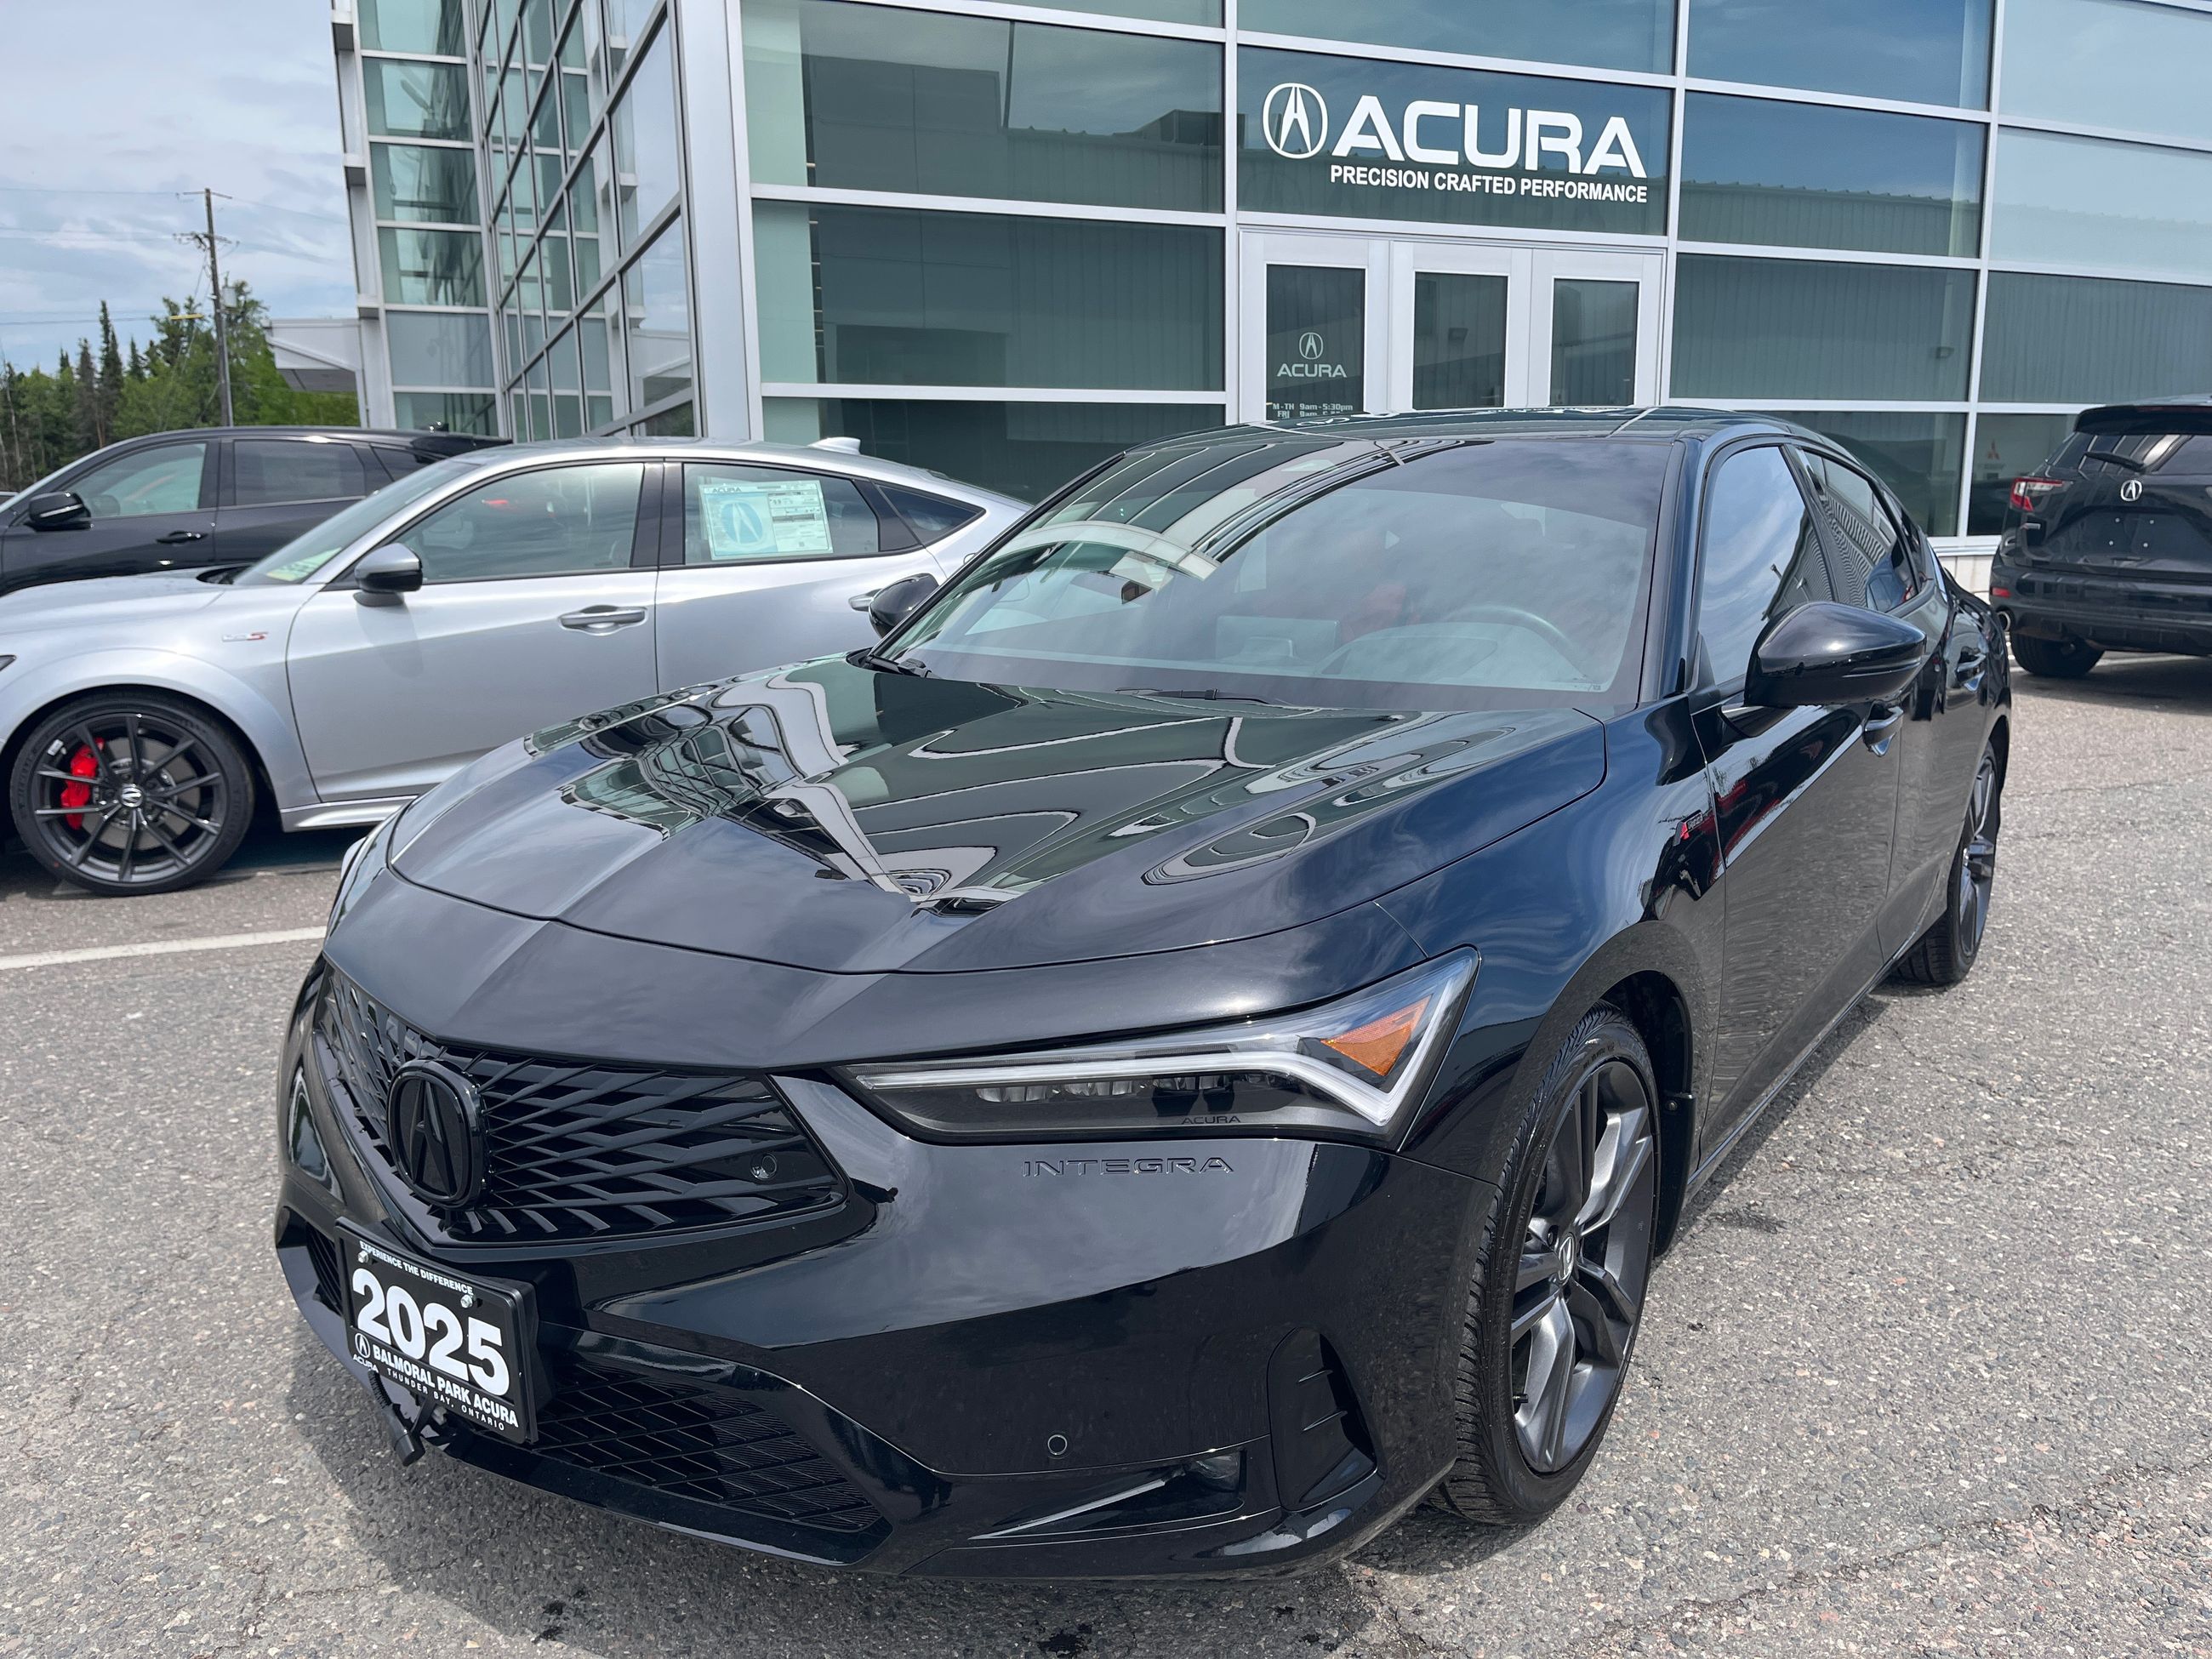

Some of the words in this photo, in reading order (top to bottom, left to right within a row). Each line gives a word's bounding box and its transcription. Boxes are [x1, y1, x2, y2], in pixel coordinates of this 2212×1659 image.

[1331, 94, 1647, 178] ACURA
[1331, 165, 1429, 190] PRECISION
[1434, 173, 1516, 195] CRAFTED
[1520, 178, 1647, 203] PERFORMANCE
[1276, 363, 1348, 378] ACURA
[1181, 1115, 1241, 1125] ACURA
[1022, 1157, 1234, 1177] INTEGRA
[359, 1240, 403, 1269] EXPERIENCE
[402, 1262, 419, 1277] THE
[420, 1268, 474, 1296] DIFFERENCE
[352, 1268, 510, 1396] 2025
[352, 1354, 379, 1373] ACURA
[373, 1344, 436, 1388] BALMORAL
[436, 1376, 472, 1405] PARK
[473, 1393, 519, 1428] ACURA
[386, 1367, 428, 1394] THUNDER
[461, 1405, 505, 1431] ONTARIO
